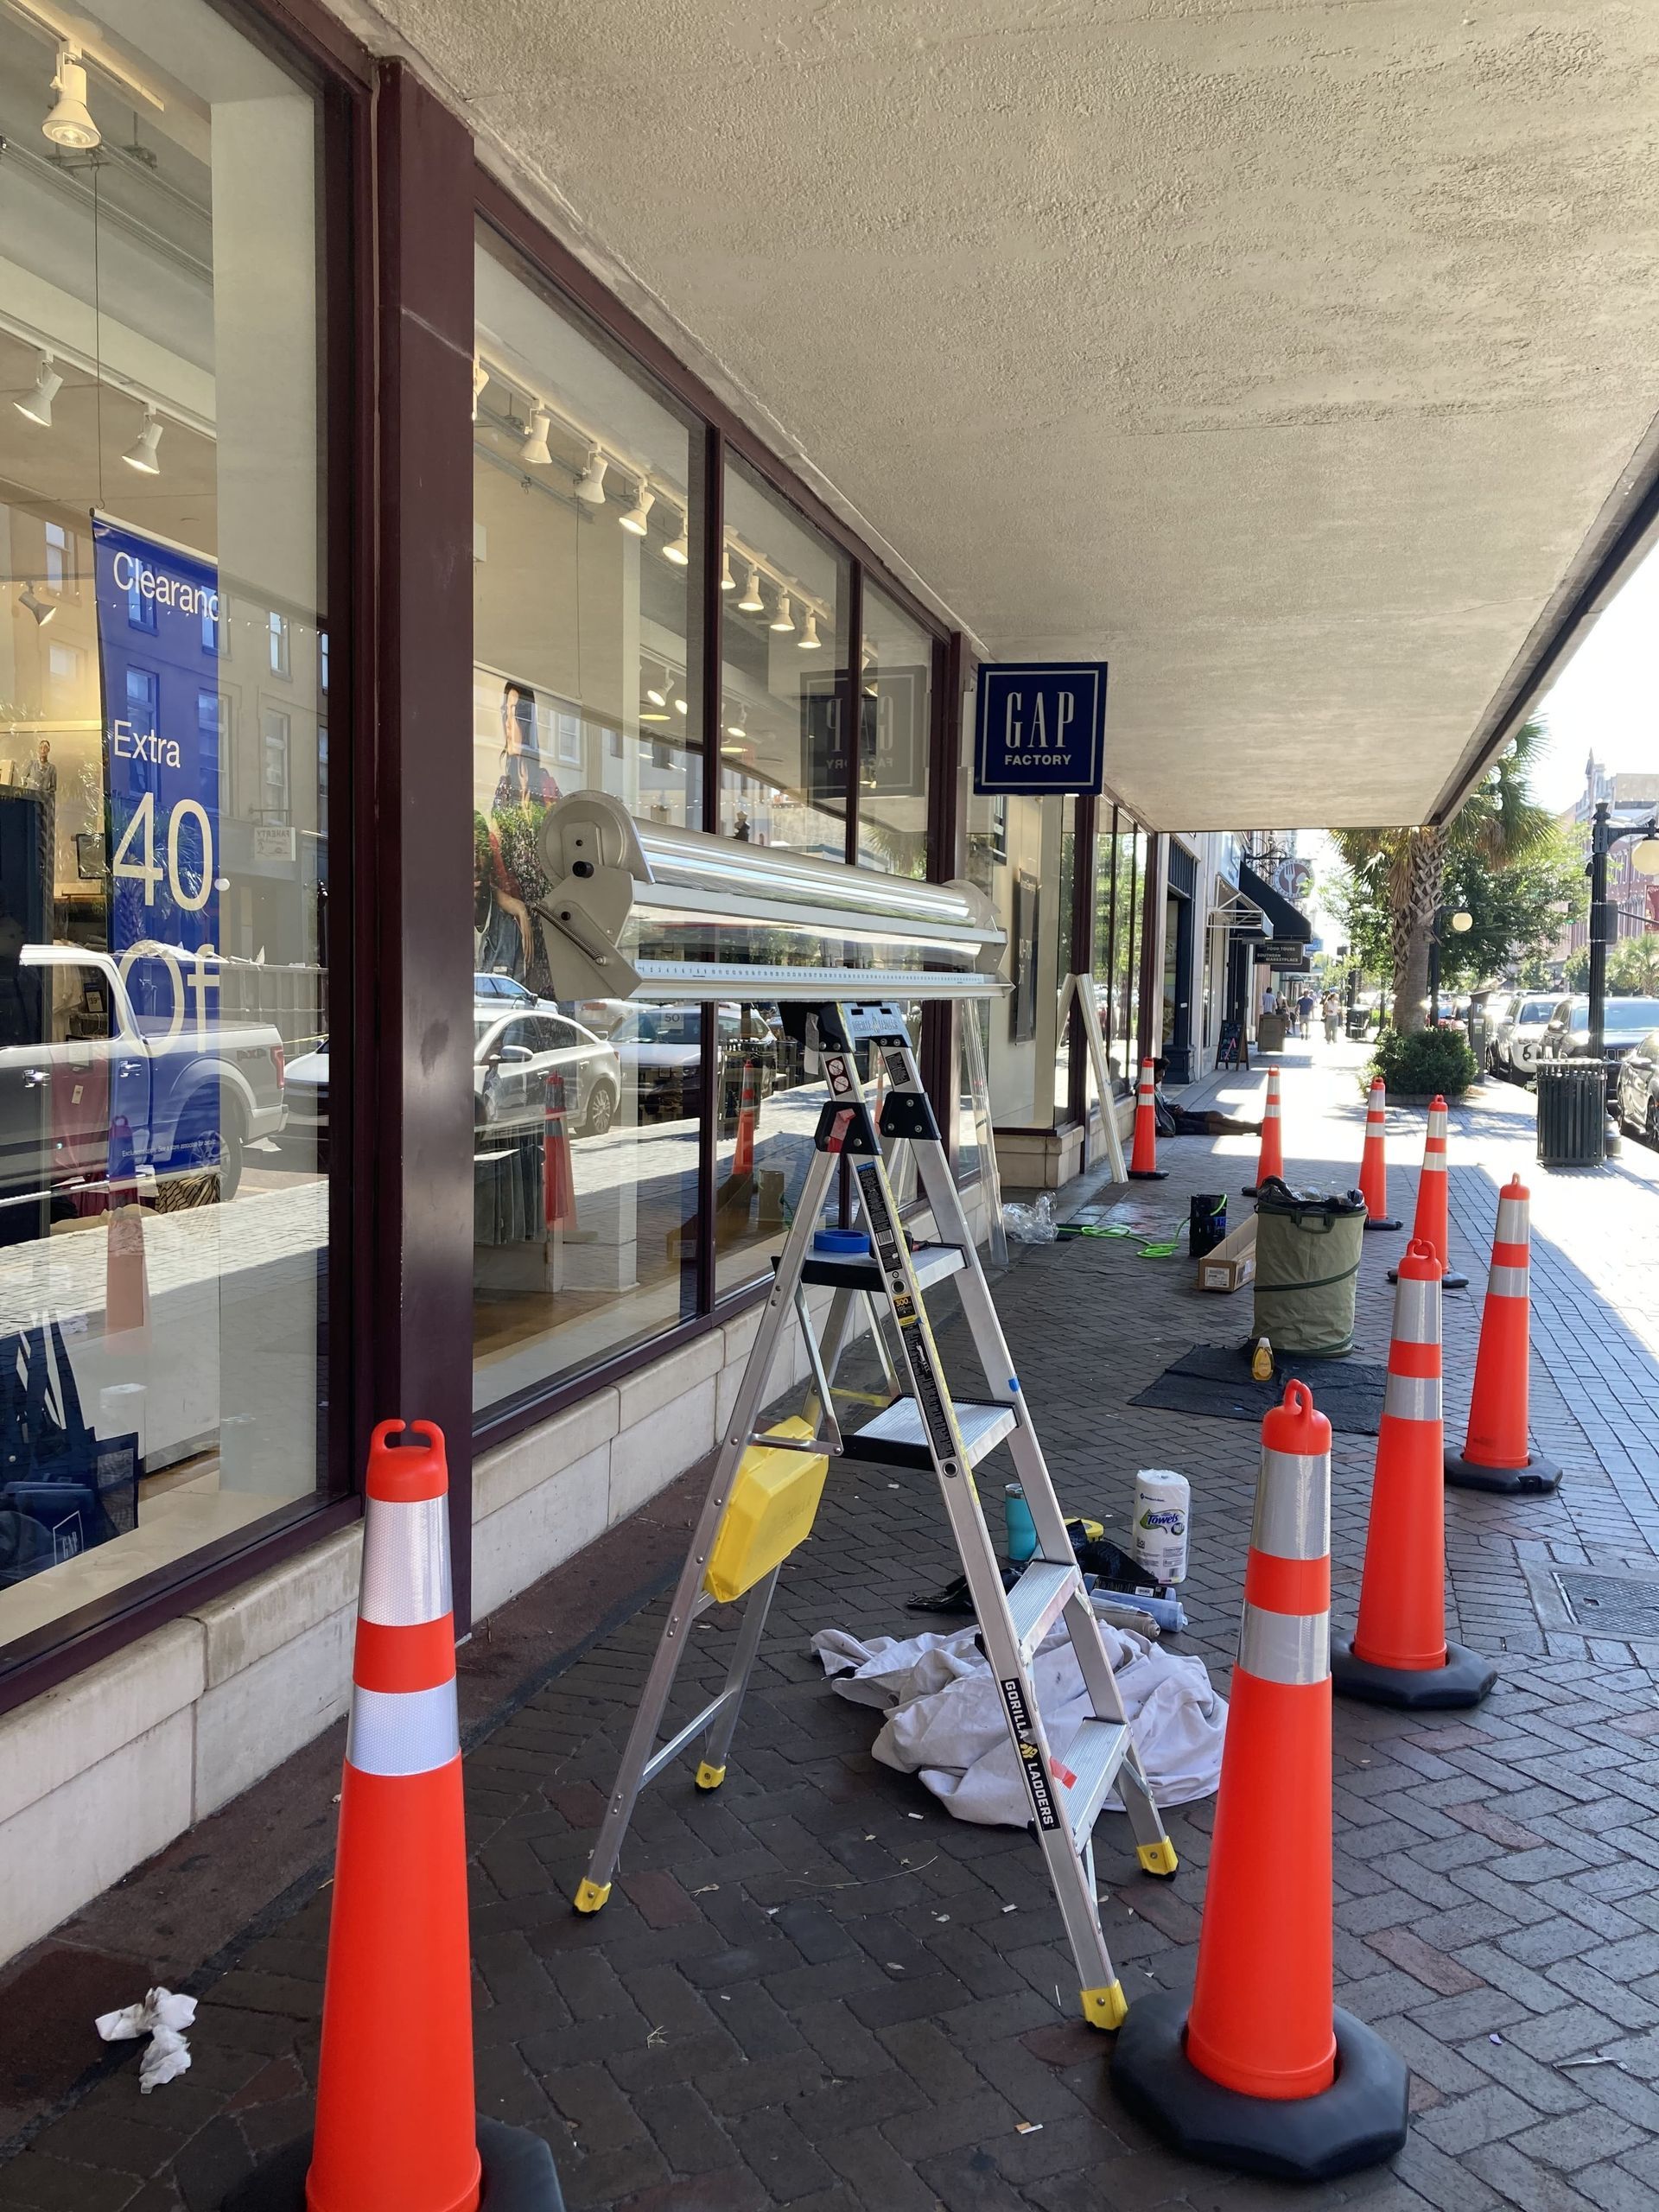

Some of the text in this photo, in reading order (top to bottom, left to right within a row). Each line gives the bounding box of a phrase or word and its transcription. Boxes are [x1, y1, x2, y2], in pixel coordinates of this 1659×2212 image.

[1006, 691, 1074, 748] GAP
[114, 720, 181, 769] Extra
[1004, 754, 1071, 766] FACTORY
[112, 791, 213, 912] 40
[116, 939, 220, 1058] Of
[1477, 1004, 1483, 1013] P
[894, 1298, 909, 1306] 300
[1147, 1513, 1179, 1525] Towels
[1005, 1681, 1053, 1825] GORILLA LADDERS
